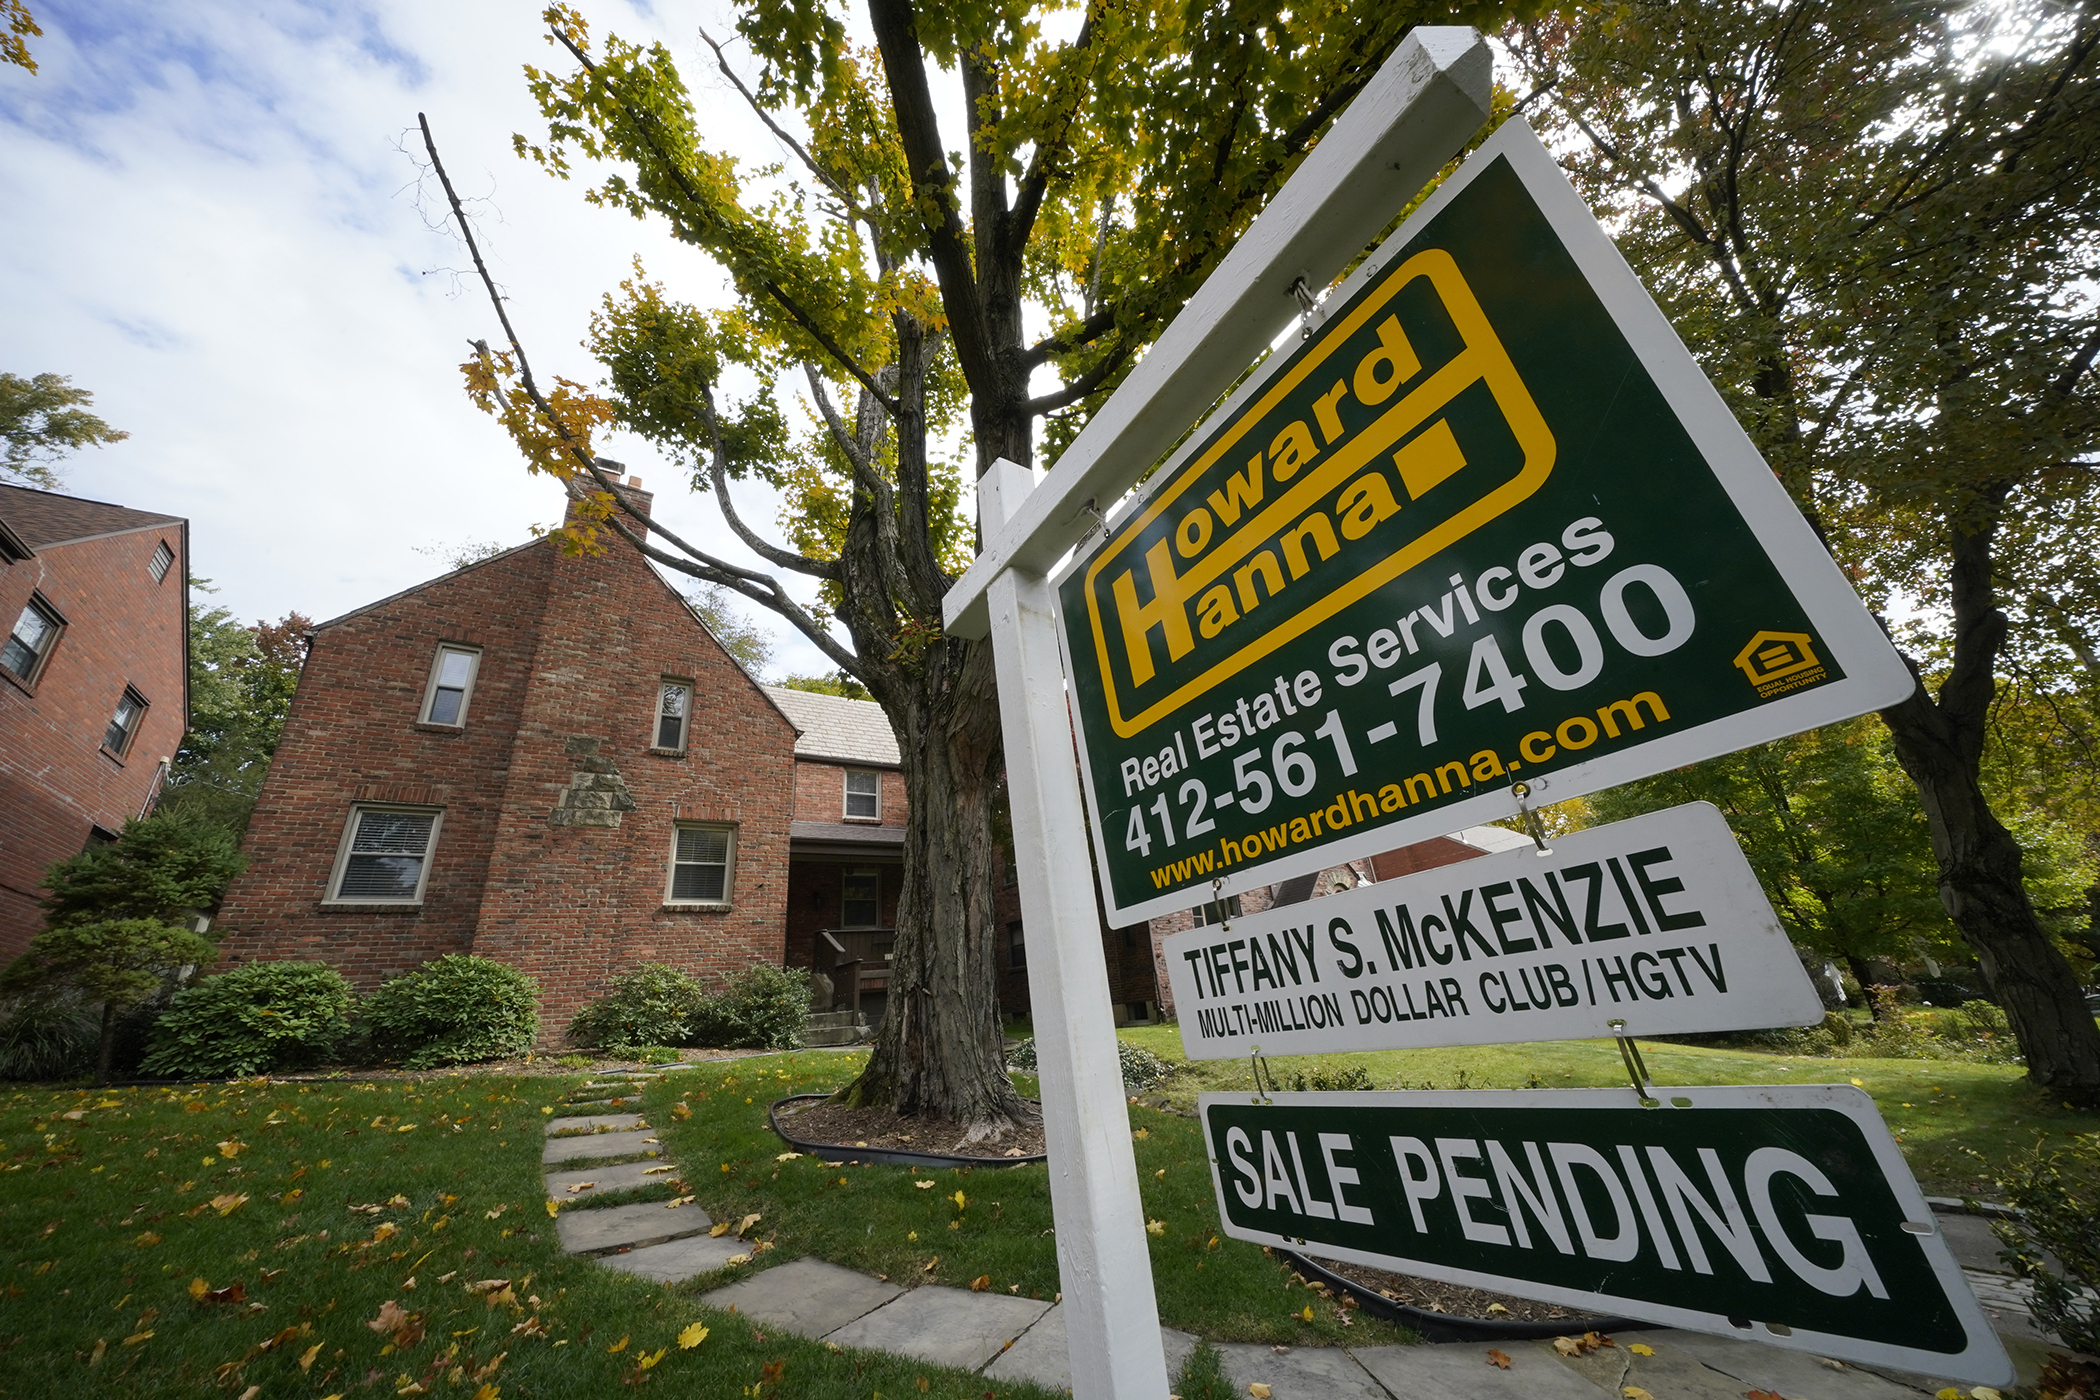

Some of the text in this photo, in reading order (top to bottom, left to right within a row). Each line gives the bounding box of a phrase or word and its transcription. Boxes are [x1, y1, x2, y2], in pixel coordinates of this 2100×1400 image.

[1111, 312, 1423, 688] Howard
[1111, 471, 1402, 688] Hanna
[1120, 516, 1615, 798] Real Estate Services
[1125, 563, 1696, 858] 412-561-7400
[1756, 666, 1825, 693] EQUAL HOUSING
[1760, 672, 1827, 698] OPPORTUNITY
[1149, 690, 1671, 890] www.howardhanna.com
[1183, 845, 1708, 1000] TIFFANY S. McKENZIE
[1196, 992, 1345, 1039] MULTI-MILLION
[1349, 977, 1471, 1026] DOLLAR
[1226, 1125, 1891, 1301] SALE PENDING
